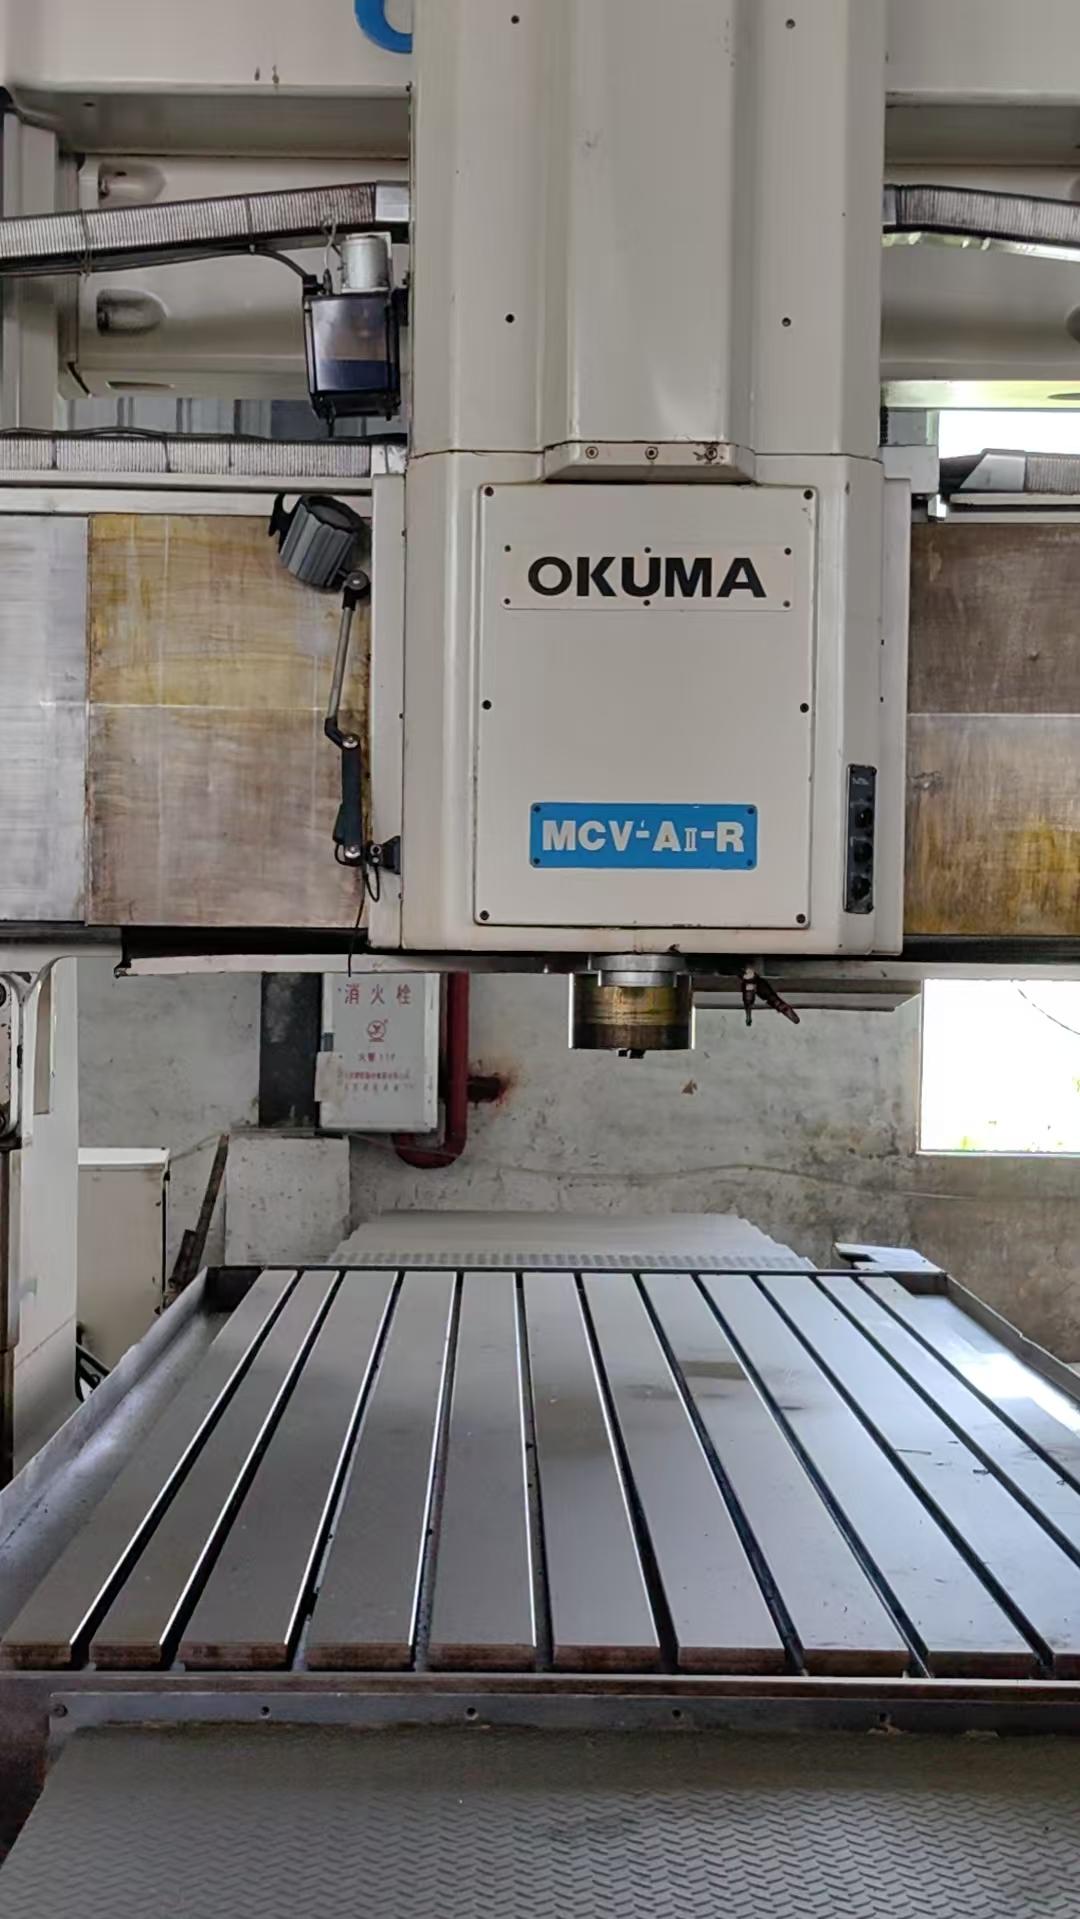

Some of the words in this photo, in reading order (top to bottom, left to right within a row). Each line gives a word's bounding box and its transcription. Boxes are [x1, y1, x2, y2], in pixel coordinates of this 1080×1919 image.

[528, 556, 767, 598] OKUMA
[345, 983, 412, 1005] 消火栓
